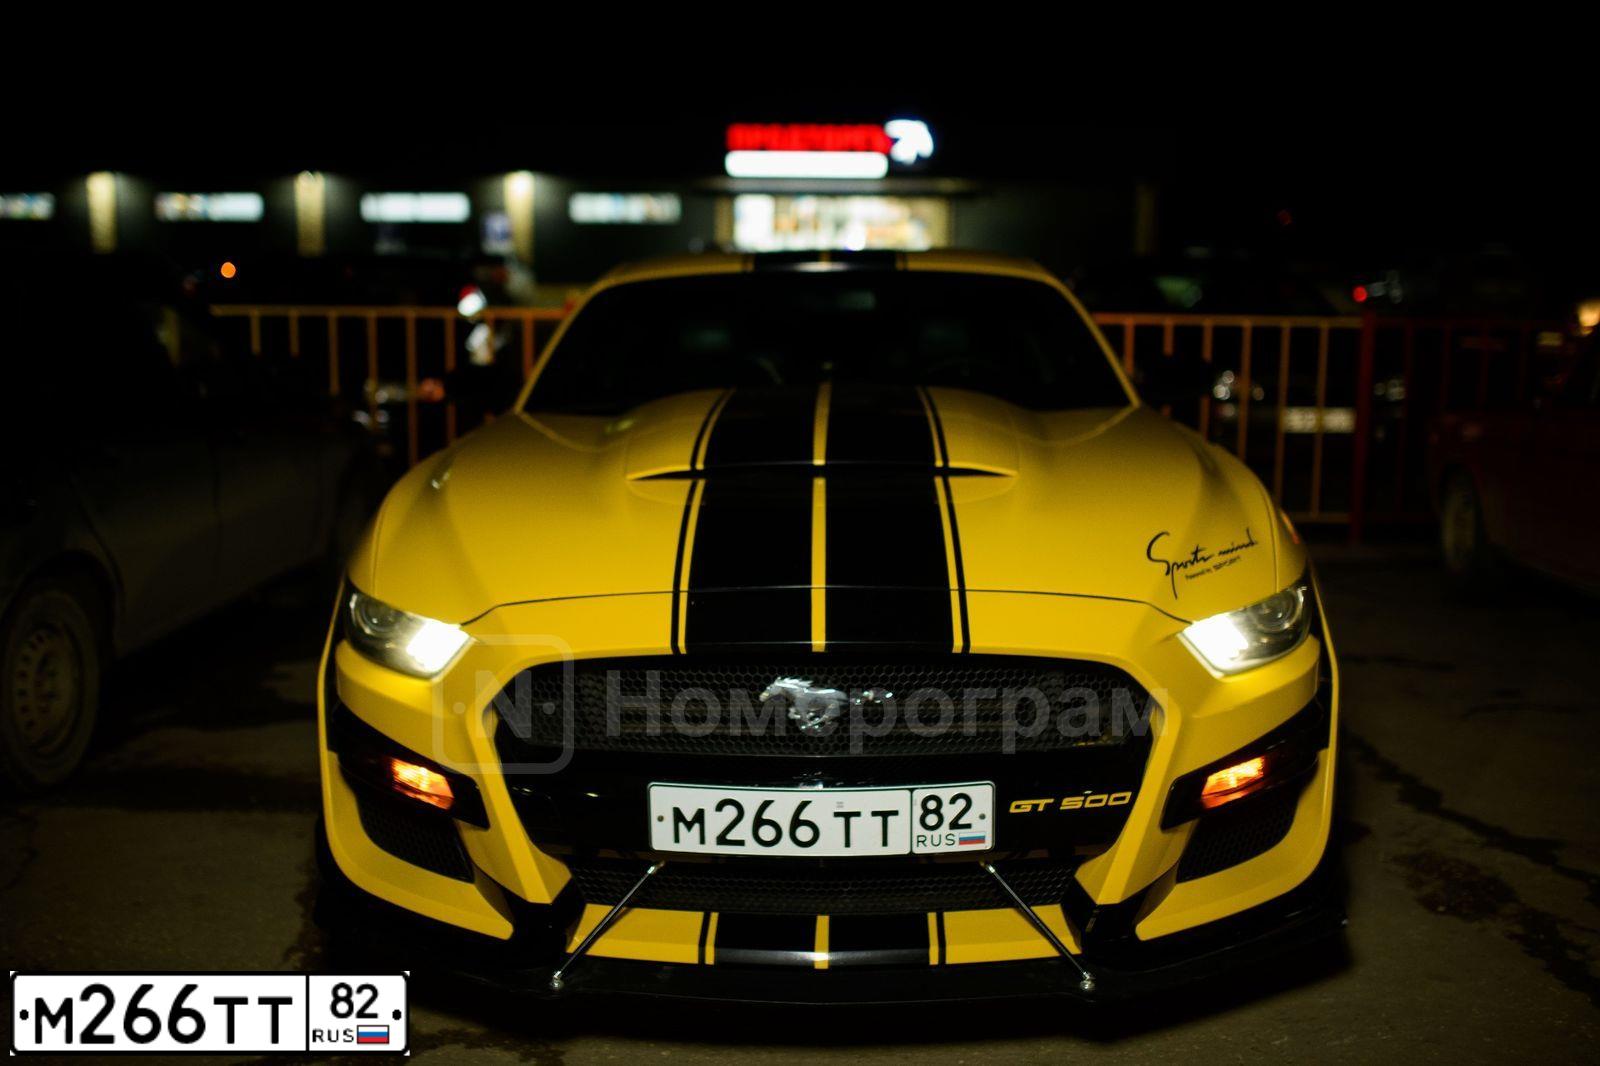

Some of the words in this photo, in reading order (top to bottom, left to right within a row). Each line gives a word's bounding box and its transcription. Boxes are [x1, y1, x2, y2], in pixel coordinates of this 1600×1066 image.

[919, 792, 973, 831] 82
[1009, 798, 1055, 813] GT
[1059, 791, 1132, 810] 500
[916, 833, 956, 848] RUS
